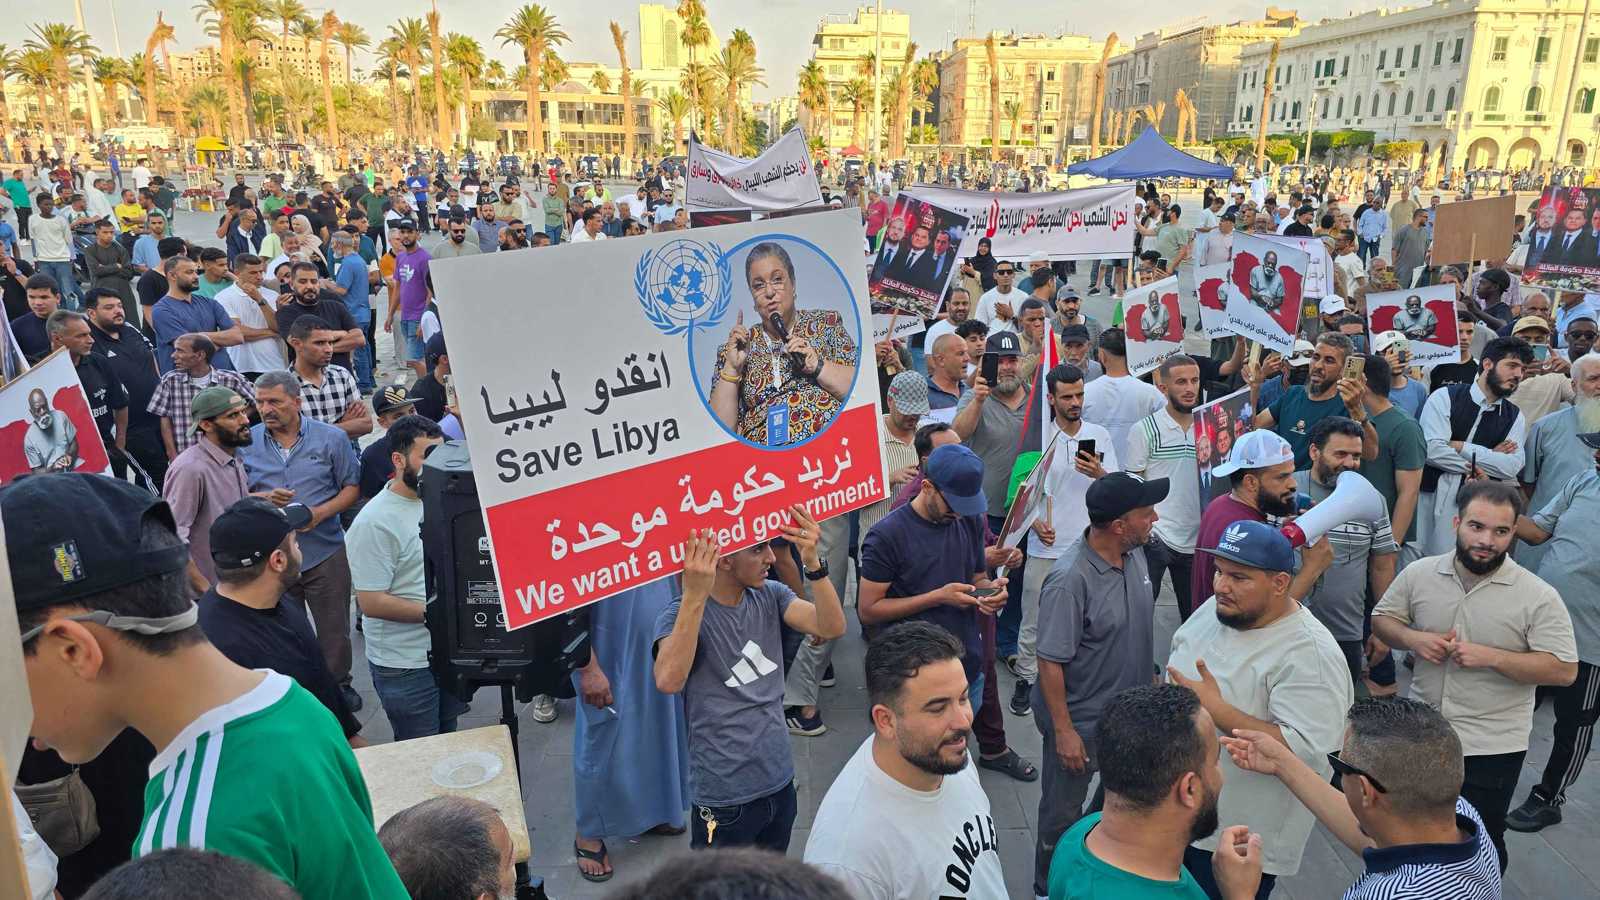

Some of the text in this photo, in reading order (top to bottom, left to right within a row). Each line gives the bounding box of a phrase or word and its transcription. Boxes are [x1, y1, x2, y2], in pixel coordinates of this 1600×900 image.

[762, 166, 782, 188] الشعب
[799, 157, 807, 175] لن
[742, 172, 762, 192] الليبي
[1021, 208, 1038, 234] نحن
[1037, 208, 1067, 235] الشرعية
[1067, 207, 1084, 233] نحن
[1083, 205, 1111, 233] الشعب
[1112, 205, 1128, 232] نحن
[480, 369, 568, 437] ليبيا
[495, 417, 680, 483] Save Libya
[548, 435, 854, 561] نريد حكومة موحدة
[515, 580, 565, 615] We
[572, 547, 642, 598] want
[648, 549, 664, 574] a
[752, 474, 881, 541] govrnment.
